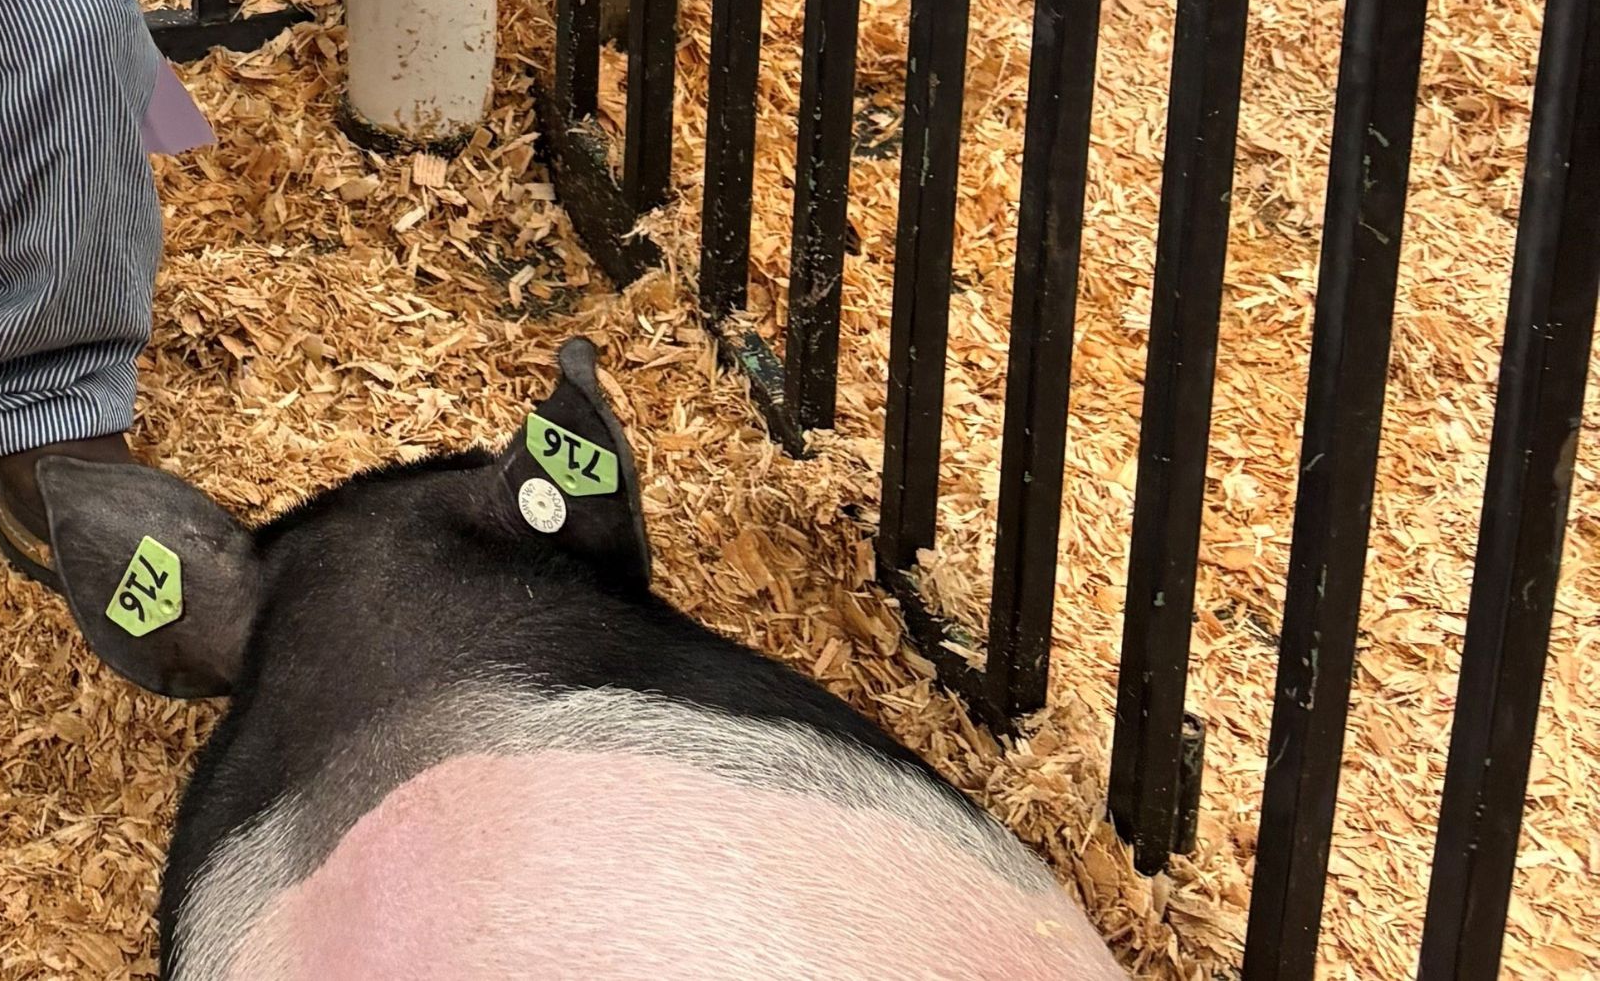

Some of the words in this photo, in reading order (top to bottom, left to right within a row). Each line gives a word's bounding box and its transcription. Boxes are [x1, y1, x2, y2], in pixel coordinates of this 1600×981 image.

[543, 428, 601, 483] 716
[542, 519, 554, 529] TO
[545, 486, 563, 525] REMOVE
[120, 554, 169, 623] 716
